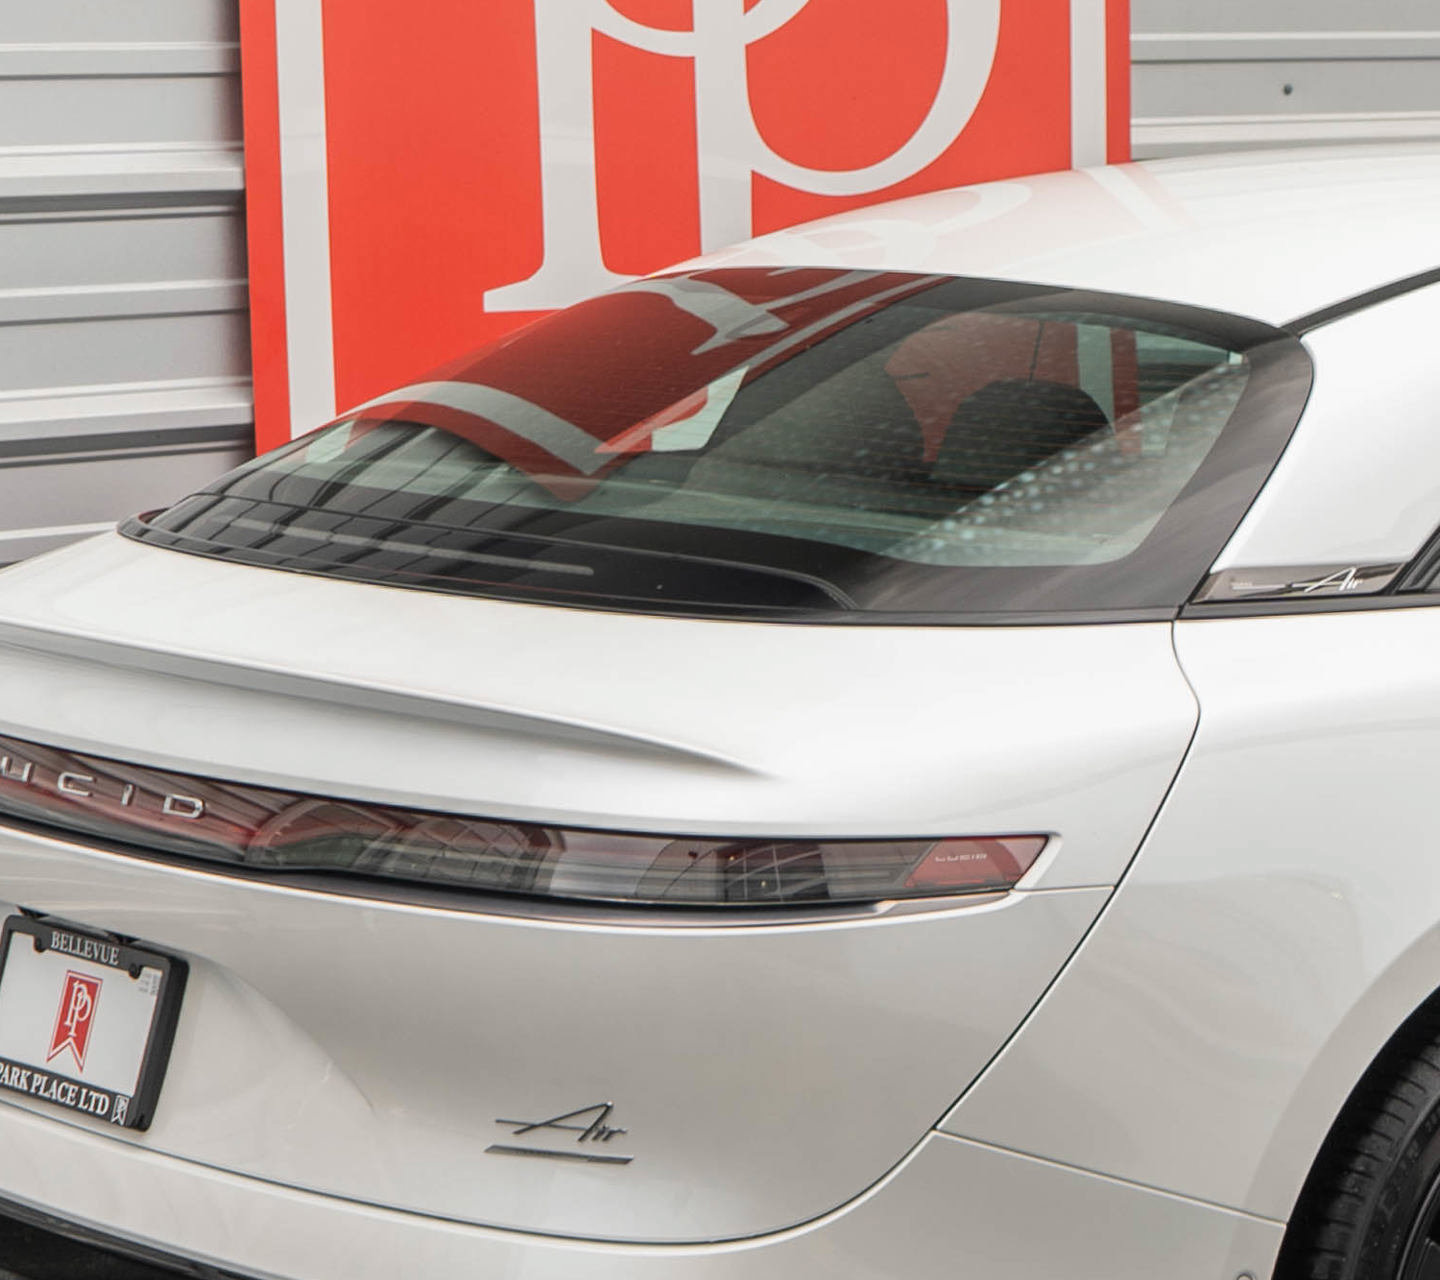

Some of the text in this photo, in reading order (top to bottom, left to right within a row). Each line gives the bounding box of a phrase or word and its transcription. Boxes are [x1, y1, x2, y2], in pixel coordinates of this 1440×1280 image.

[50, 931, 120, 966] BELLEVUE
[29, 1074, 78, 1107] PLACE
[79, 1087, 111, 1117] LTD
[495, 1101, 628, 1142] Air
